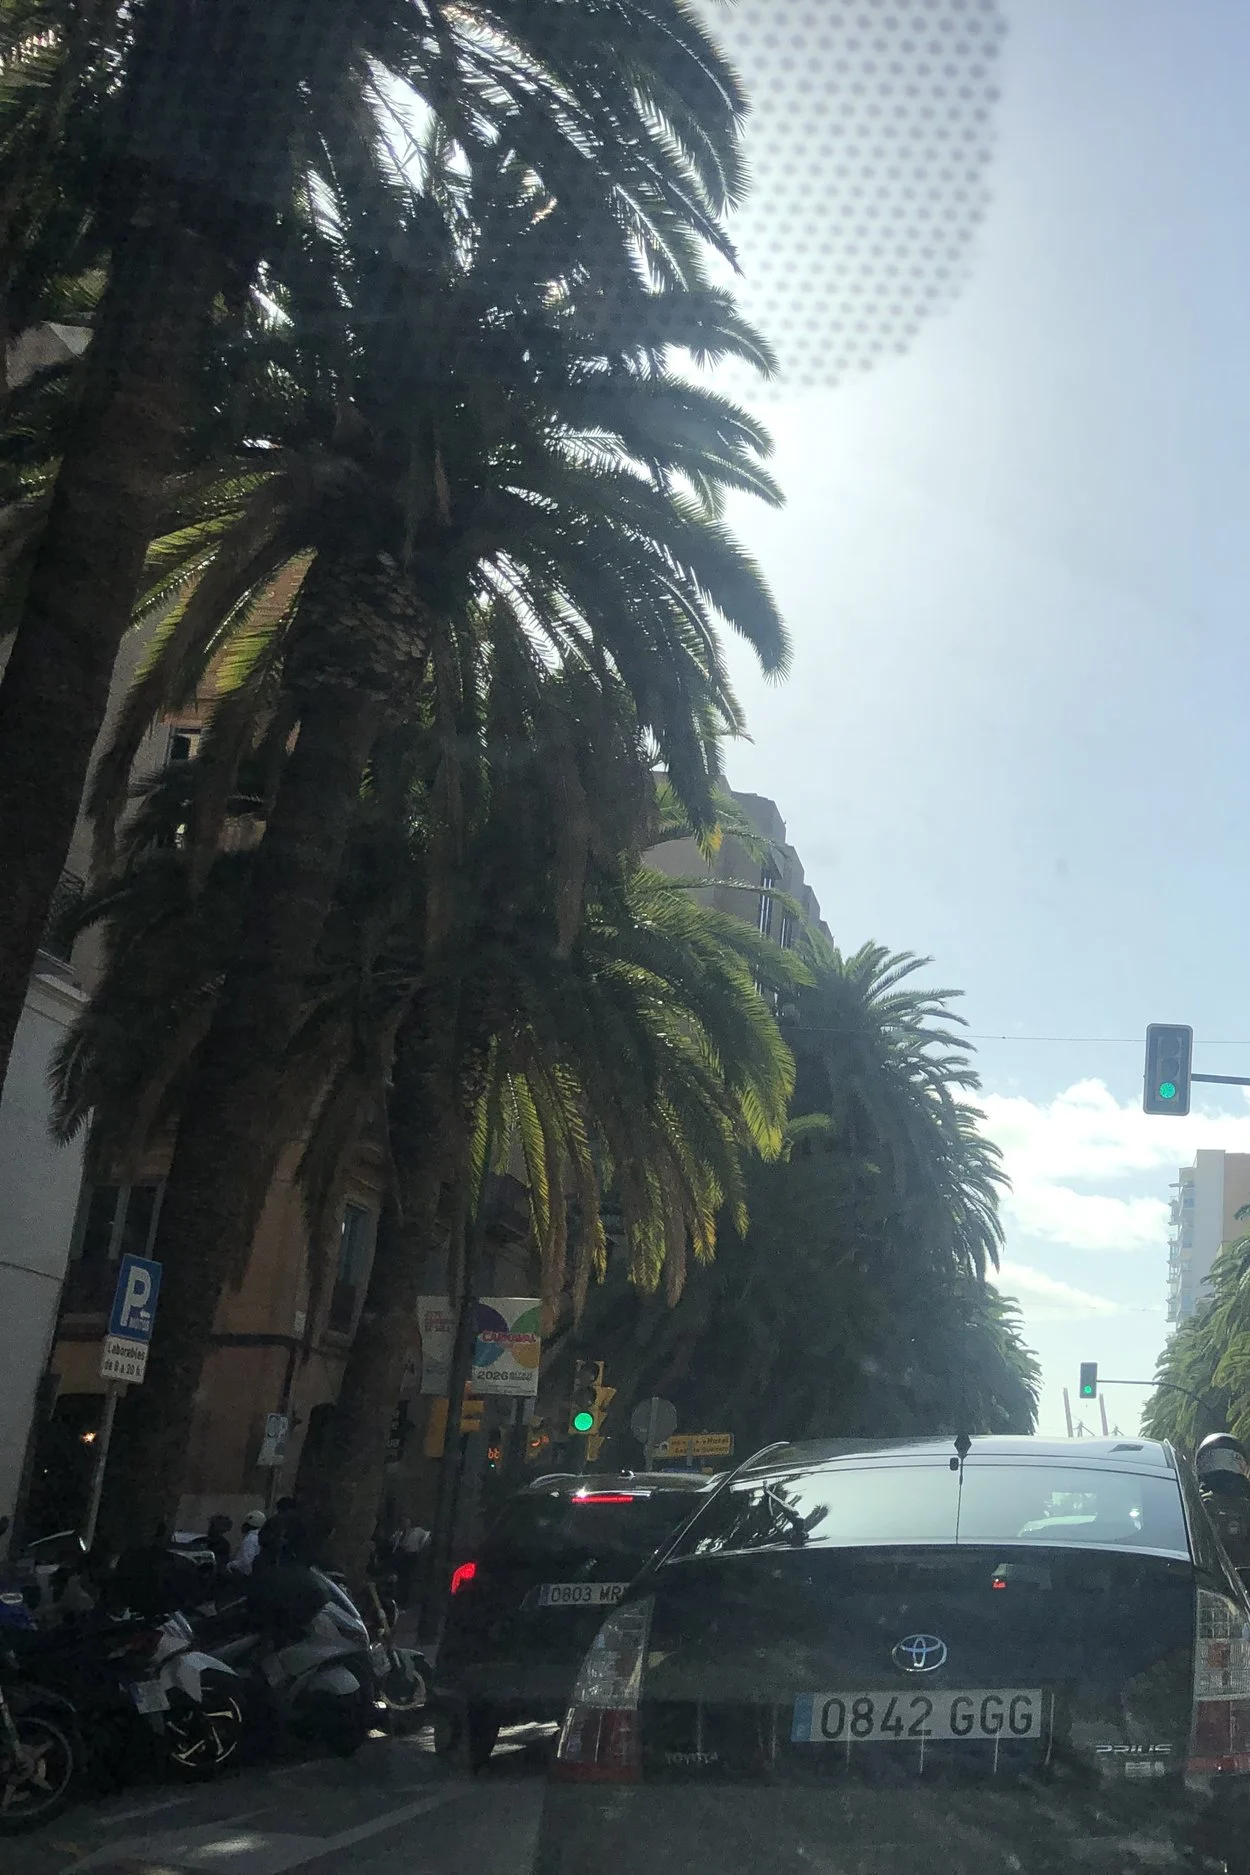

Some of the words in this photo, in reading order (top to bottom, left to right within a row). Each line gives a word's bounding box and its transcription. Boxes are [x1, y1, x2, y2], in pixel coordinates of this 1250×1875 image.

[120, 1265, 151, 1327] P
[478, 1371, 508, 1381] 2026
[599, 1585, 626, 1601] MR
[820, 1696, 932, 1738] 0842
[949, 1694, 1034, 1735] GGG
